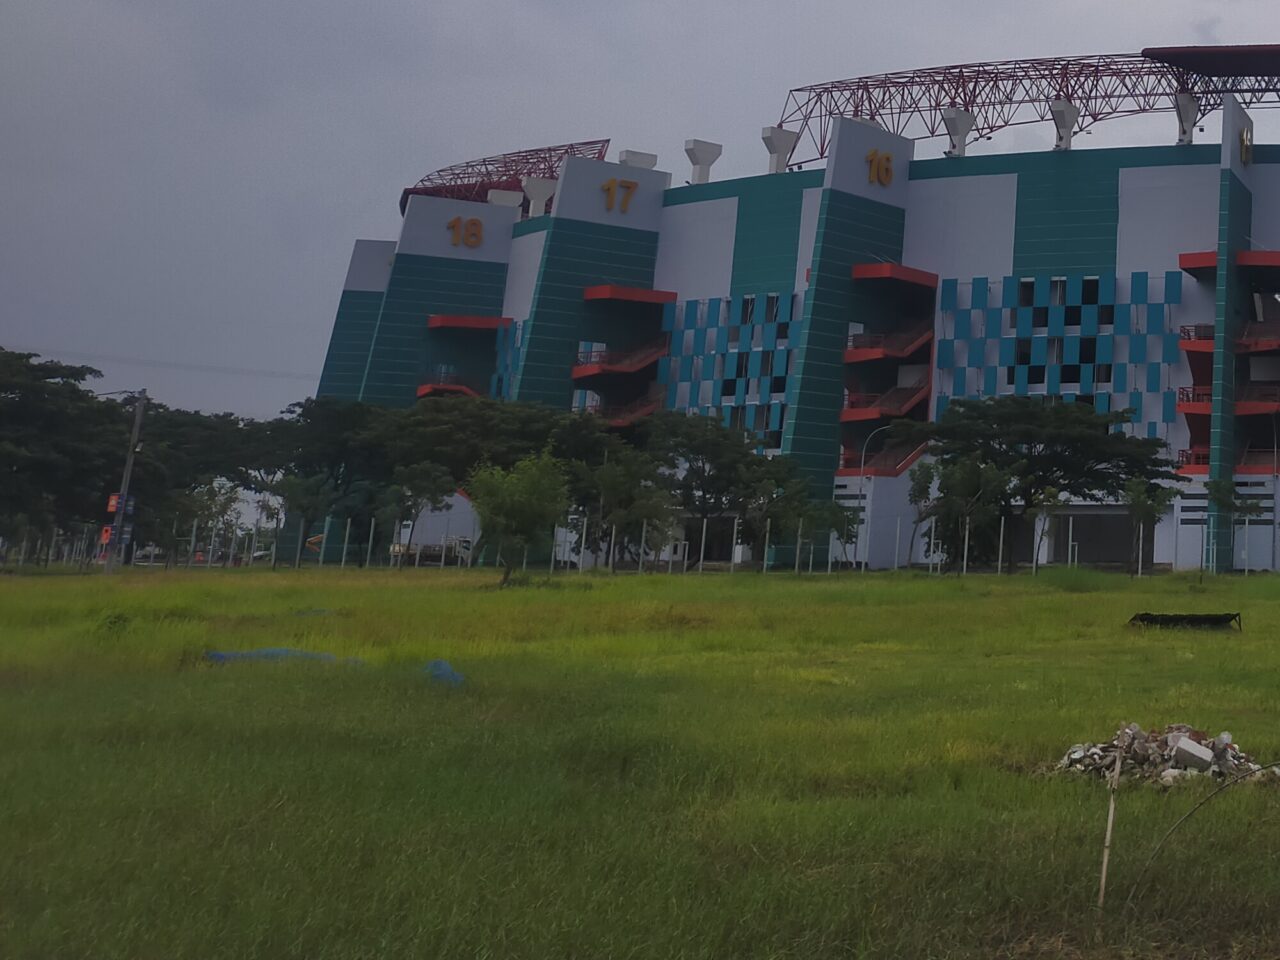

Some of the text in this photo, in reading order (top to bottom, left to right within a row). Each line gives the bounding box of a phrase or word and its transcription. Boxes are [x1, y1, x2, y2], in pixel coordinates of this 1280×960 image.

[865, 148, 893, 187] 16
[602, 178, 639, 214] 17
[447, 216, 483, 249] 18
